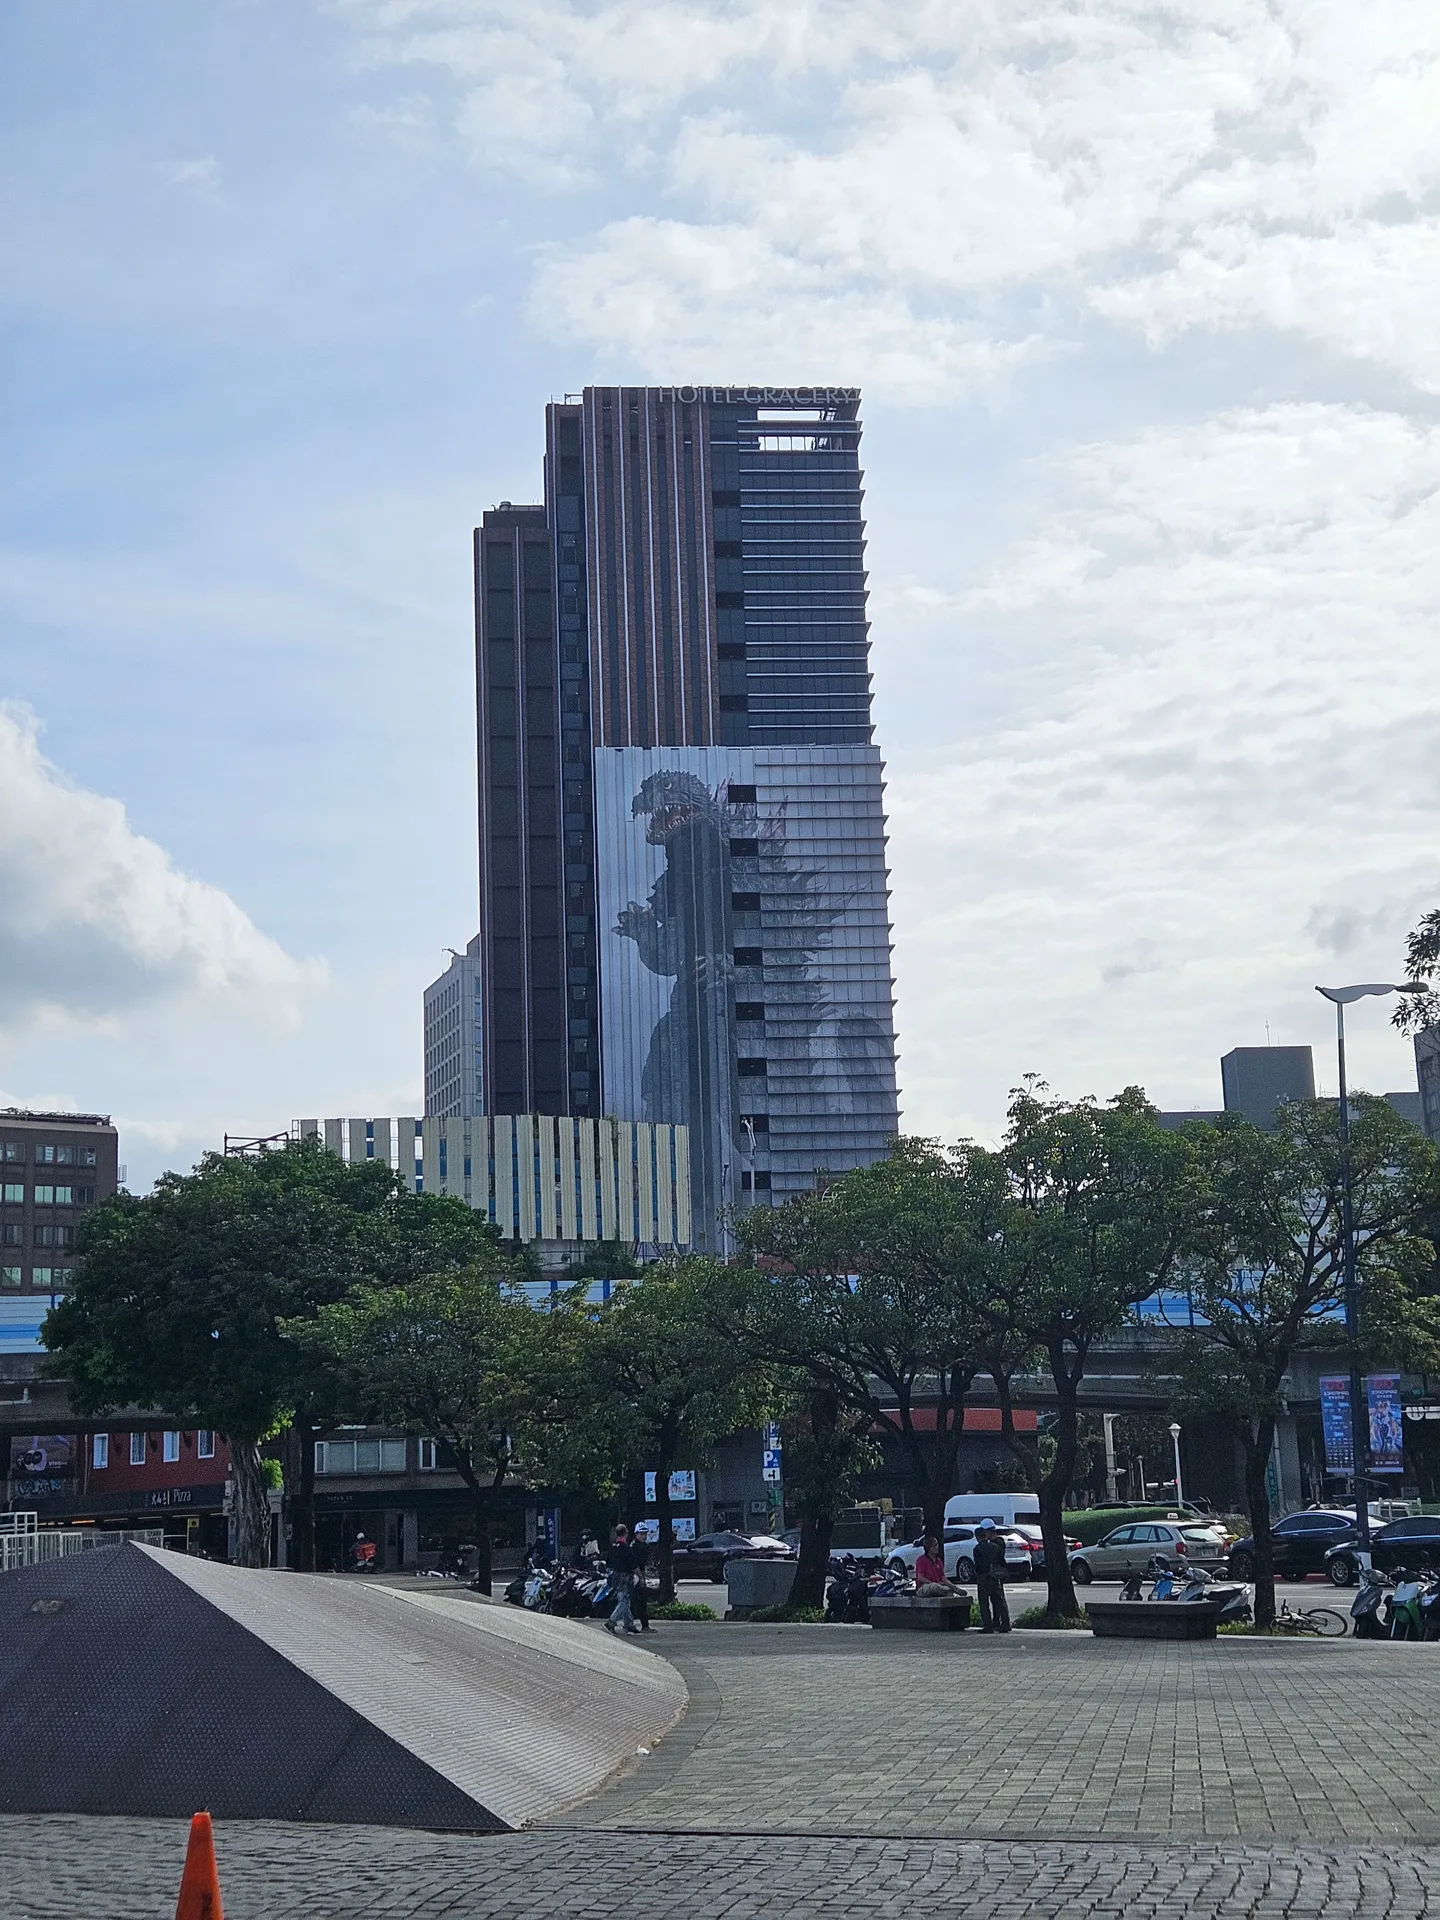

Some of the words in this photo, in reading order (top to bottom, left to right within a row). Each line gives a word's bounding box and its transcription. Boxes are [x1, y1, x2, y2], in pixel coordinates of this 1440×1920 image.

[658, 386, 738, 403] HOTEL
[743, 386, 855, 404] GRACERY
[763, 1450, 774, 1467] P
[173, 1488, 191, 1503] Pizza
